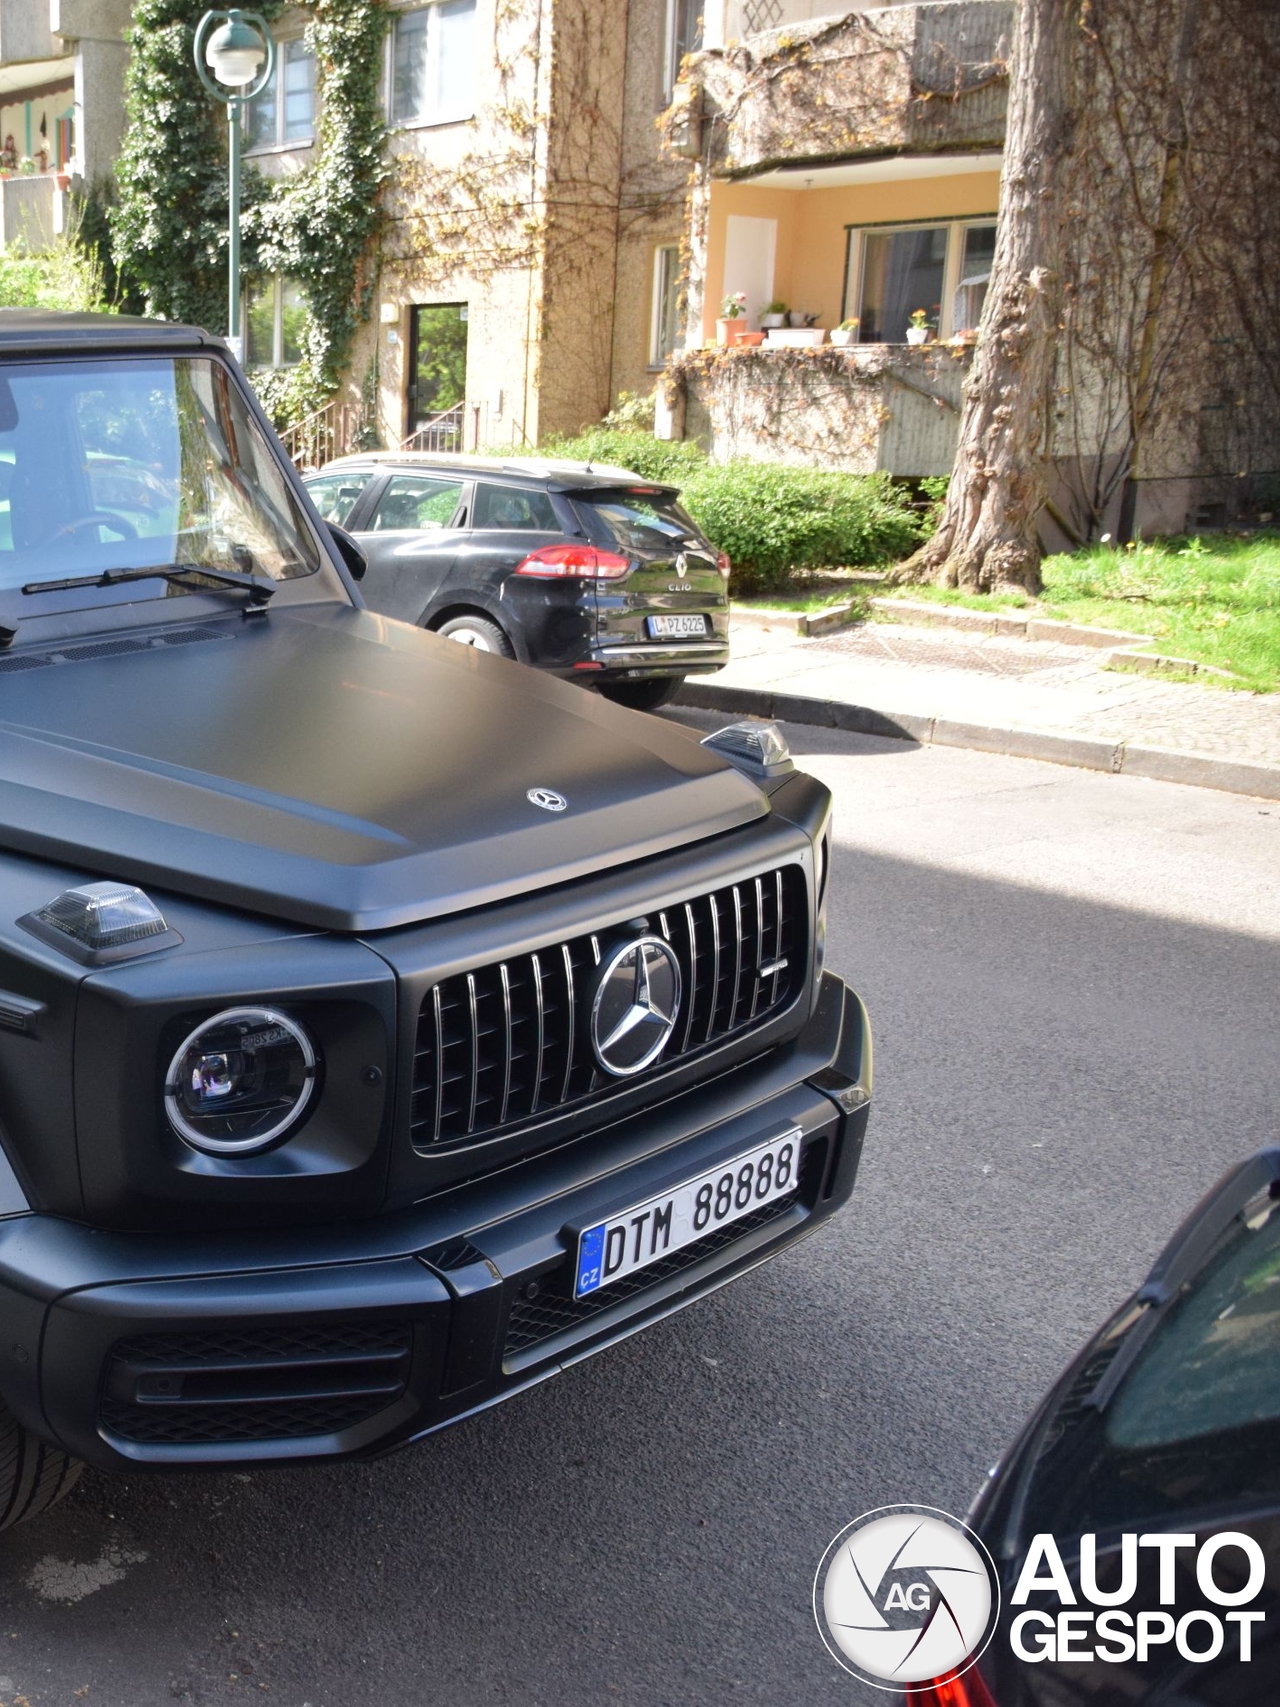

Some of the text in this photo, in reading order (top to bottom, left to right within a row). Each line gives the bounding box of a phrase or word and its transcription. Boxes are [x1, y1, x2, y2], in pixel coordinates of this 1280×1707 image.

[668, 583, 692, 592] CLIO
[654, 617, 705, 633] L PZ 6225
[603, 1143, 794, 1278] DTM 88888
[580, 1266, 598, 1287] CZ
